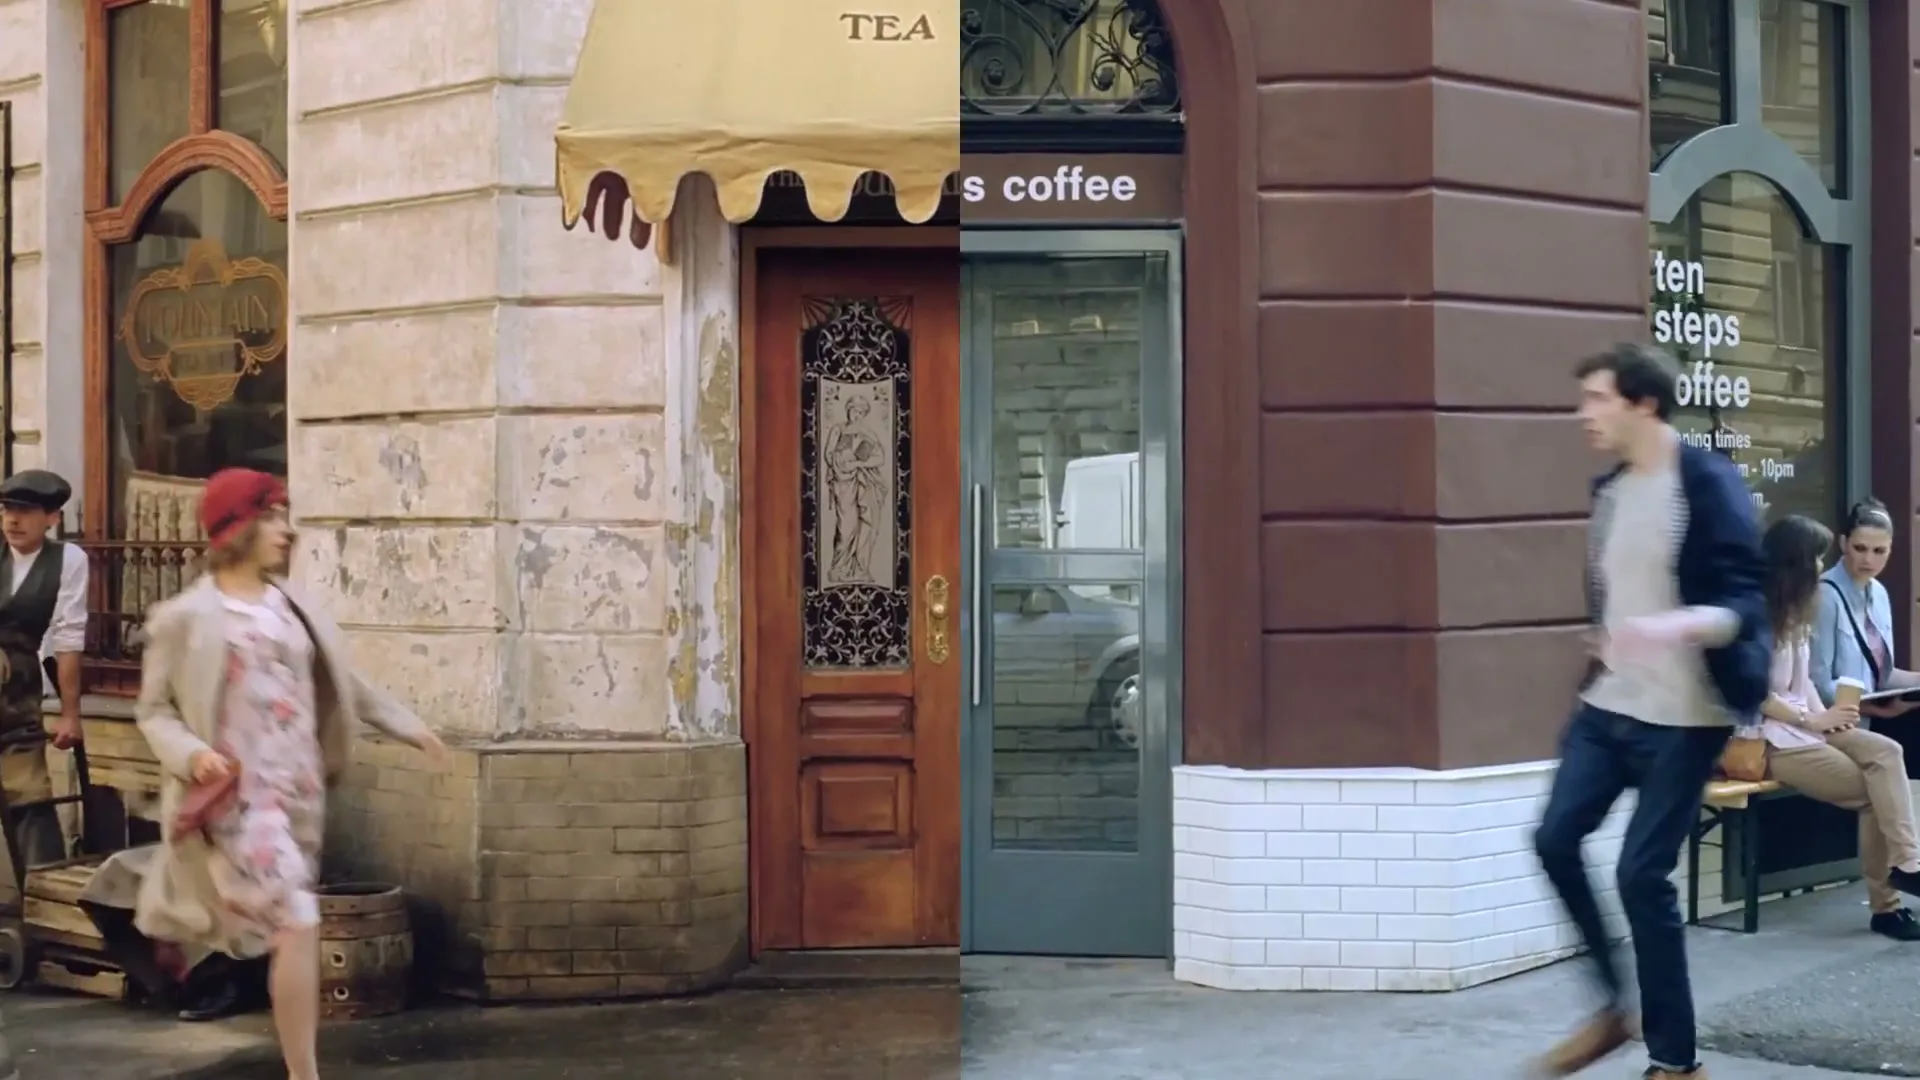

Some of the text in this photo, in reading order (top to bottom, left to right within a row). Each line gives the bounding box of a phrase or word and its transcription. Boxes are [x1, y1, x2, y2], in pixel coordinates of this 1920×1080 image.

[839, 13, 936, 41] TEA
[1003, 165, 1137, 202] coffee
[1654, 250, 1704, 294] ten
[1654, 303, 1741, 358] steps
[1675, 360, 1751, 408] offee
[1715, 429, 1752, 448] times
[1760, 458, 1795, 483] 10pm
